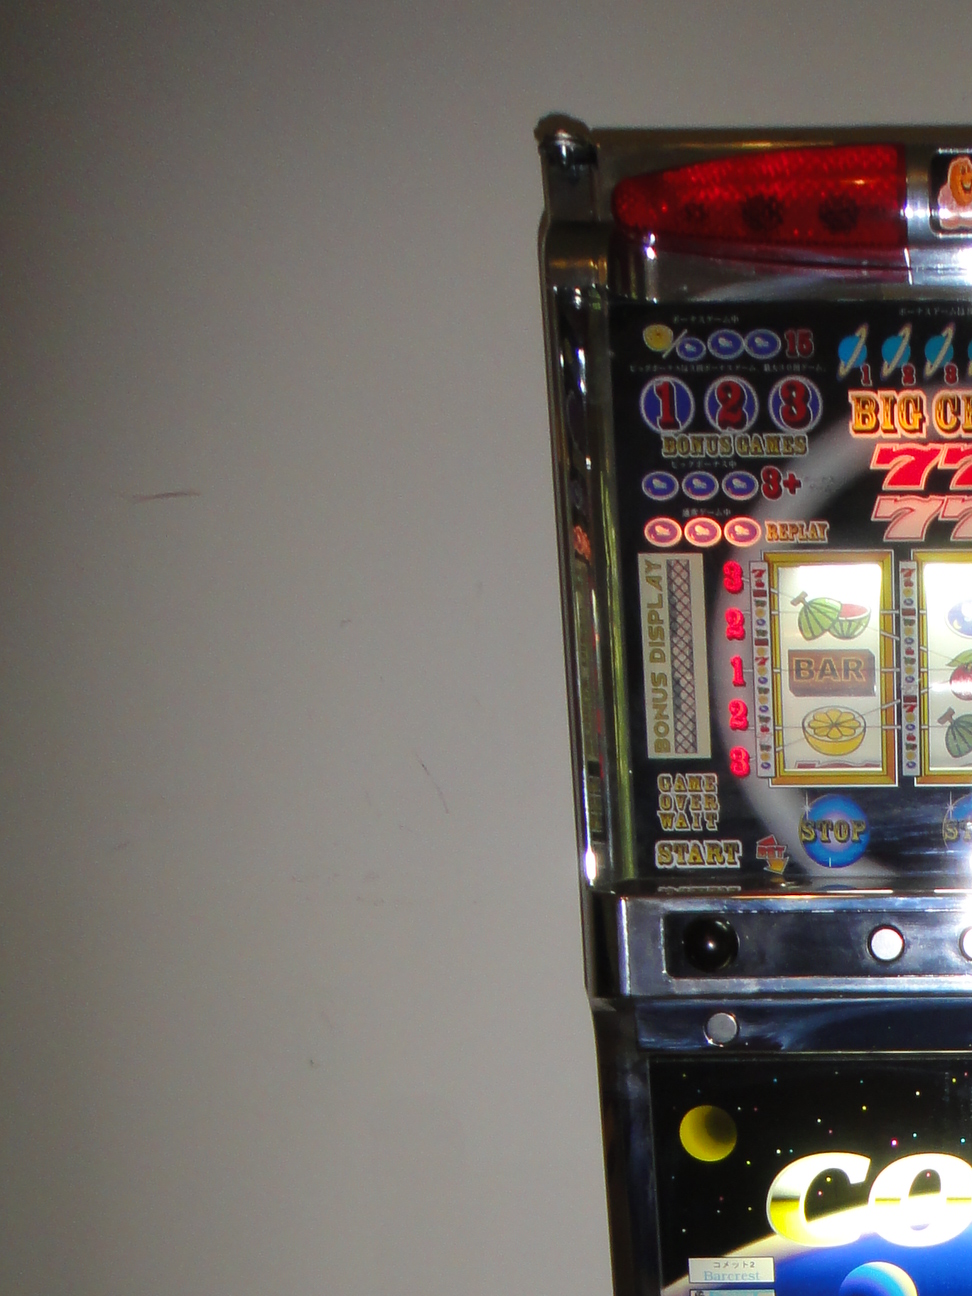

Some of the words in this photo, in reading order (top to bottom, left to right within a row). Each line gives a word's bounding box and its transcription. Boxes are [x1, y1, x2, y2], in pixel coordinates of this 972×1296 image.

[784, 328, 815, 358] 15
[860, 362, 873, 386] 1
[901, 363, 917, 386] 2
[944, 363, 959, 385] 3
[653, 380, 682, 431] 1
[715, 379, 750, 431] 2
[780, 379, 814, 432] 3
[849, 390, 926, 438] BIG
[661, 433, 733, 458] BONUS
[736, 432, 809, 457] GAMES
[760, 465, 803, 500] 3+
[765, 521, 830, 543] REPLAY
[722, 560, 744, 594] 3
[645, 559, 667, 664] DISPLAY
[725, 607, 745, 641] 2
[729, 655, 747, 687] 1
[793, 657, 867, 683] BAR
[649, 671, 671, 754] BONUS
[728, 698, 749, 731] 2
[729, 746, 751, 778] 3
[657, 773, 719, 793] GAME
[658, 793, 721, 812] OVER
[657, 810, 720, 831] WAIT
[800, 819, 867, 844] STOP
[655, 840, 742, 869] START
[704, 1270, 760, 1281] Barcrest
